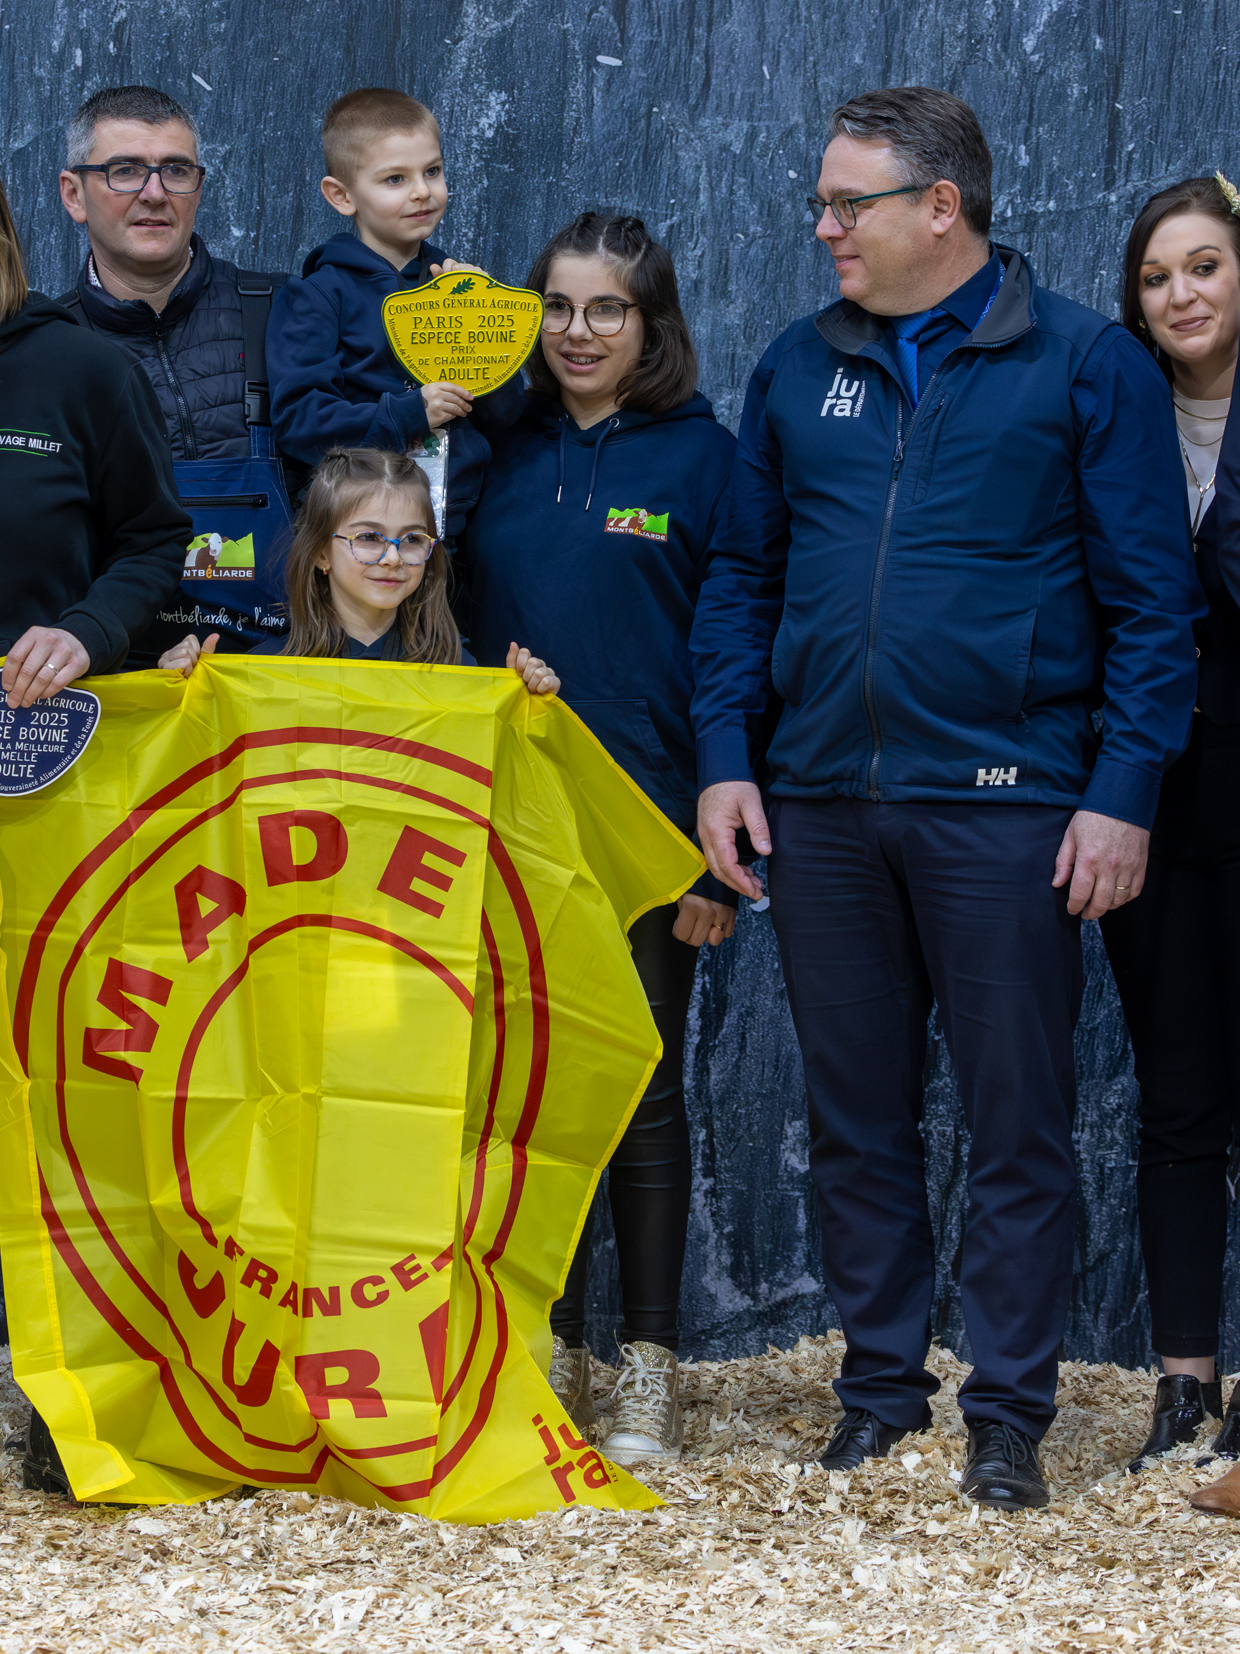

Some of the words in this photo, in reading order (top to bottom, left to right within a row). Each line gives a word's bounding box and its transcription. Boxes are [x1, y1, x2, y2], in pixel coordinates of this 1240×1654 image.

[388, 299, 440, 316] CONCOURS
[443, 296, 487, 308] GÉNÉRAL
[489, 298, 539, 313] AGRICOLE
[412, 315, 463, 329] PARIS
[478, 314, 515, 328] 2025
[528, 315, 539, 332] Forêt
[411, 331, 461, 344] ESPECE
[468, 330, 517, 343] BOVINE
[523, 339, 531, 348] de
[399, 347, 407, 356] de
[451, 345, 476, 354] PRIX
[521, 347, 527, 355] et
[418, 357, 430, 366] DE
[434, 354, 510, 366] CHAMPIONNAT
[438, 367, 490, 381] ADULTE
[493, 354, 522, 384] Alimentaire
[28, 438, 62, 453] MILLET
[236, 612, 249, 631] je
[254, 606, 286, 627] l'aime
[44, 697, 96, 714] AGRICOLE
[30, 711, 69, 727] 2025
[81, 716, 94, 733] Forêt
[18, 727, 69, 742] BOVINE
[77, 733, 86, 741] la
[0, 742, 12, 750] LA
[15, 741, 65, 753] MEILLEURE
[70, 748, 78, 756] et
[73, 740, 83, 749] de
[39, 754, 72, 784] Alimentaire
[976, 767, 1017, 786] HH
[82, 809, 467, 1090] MADE
